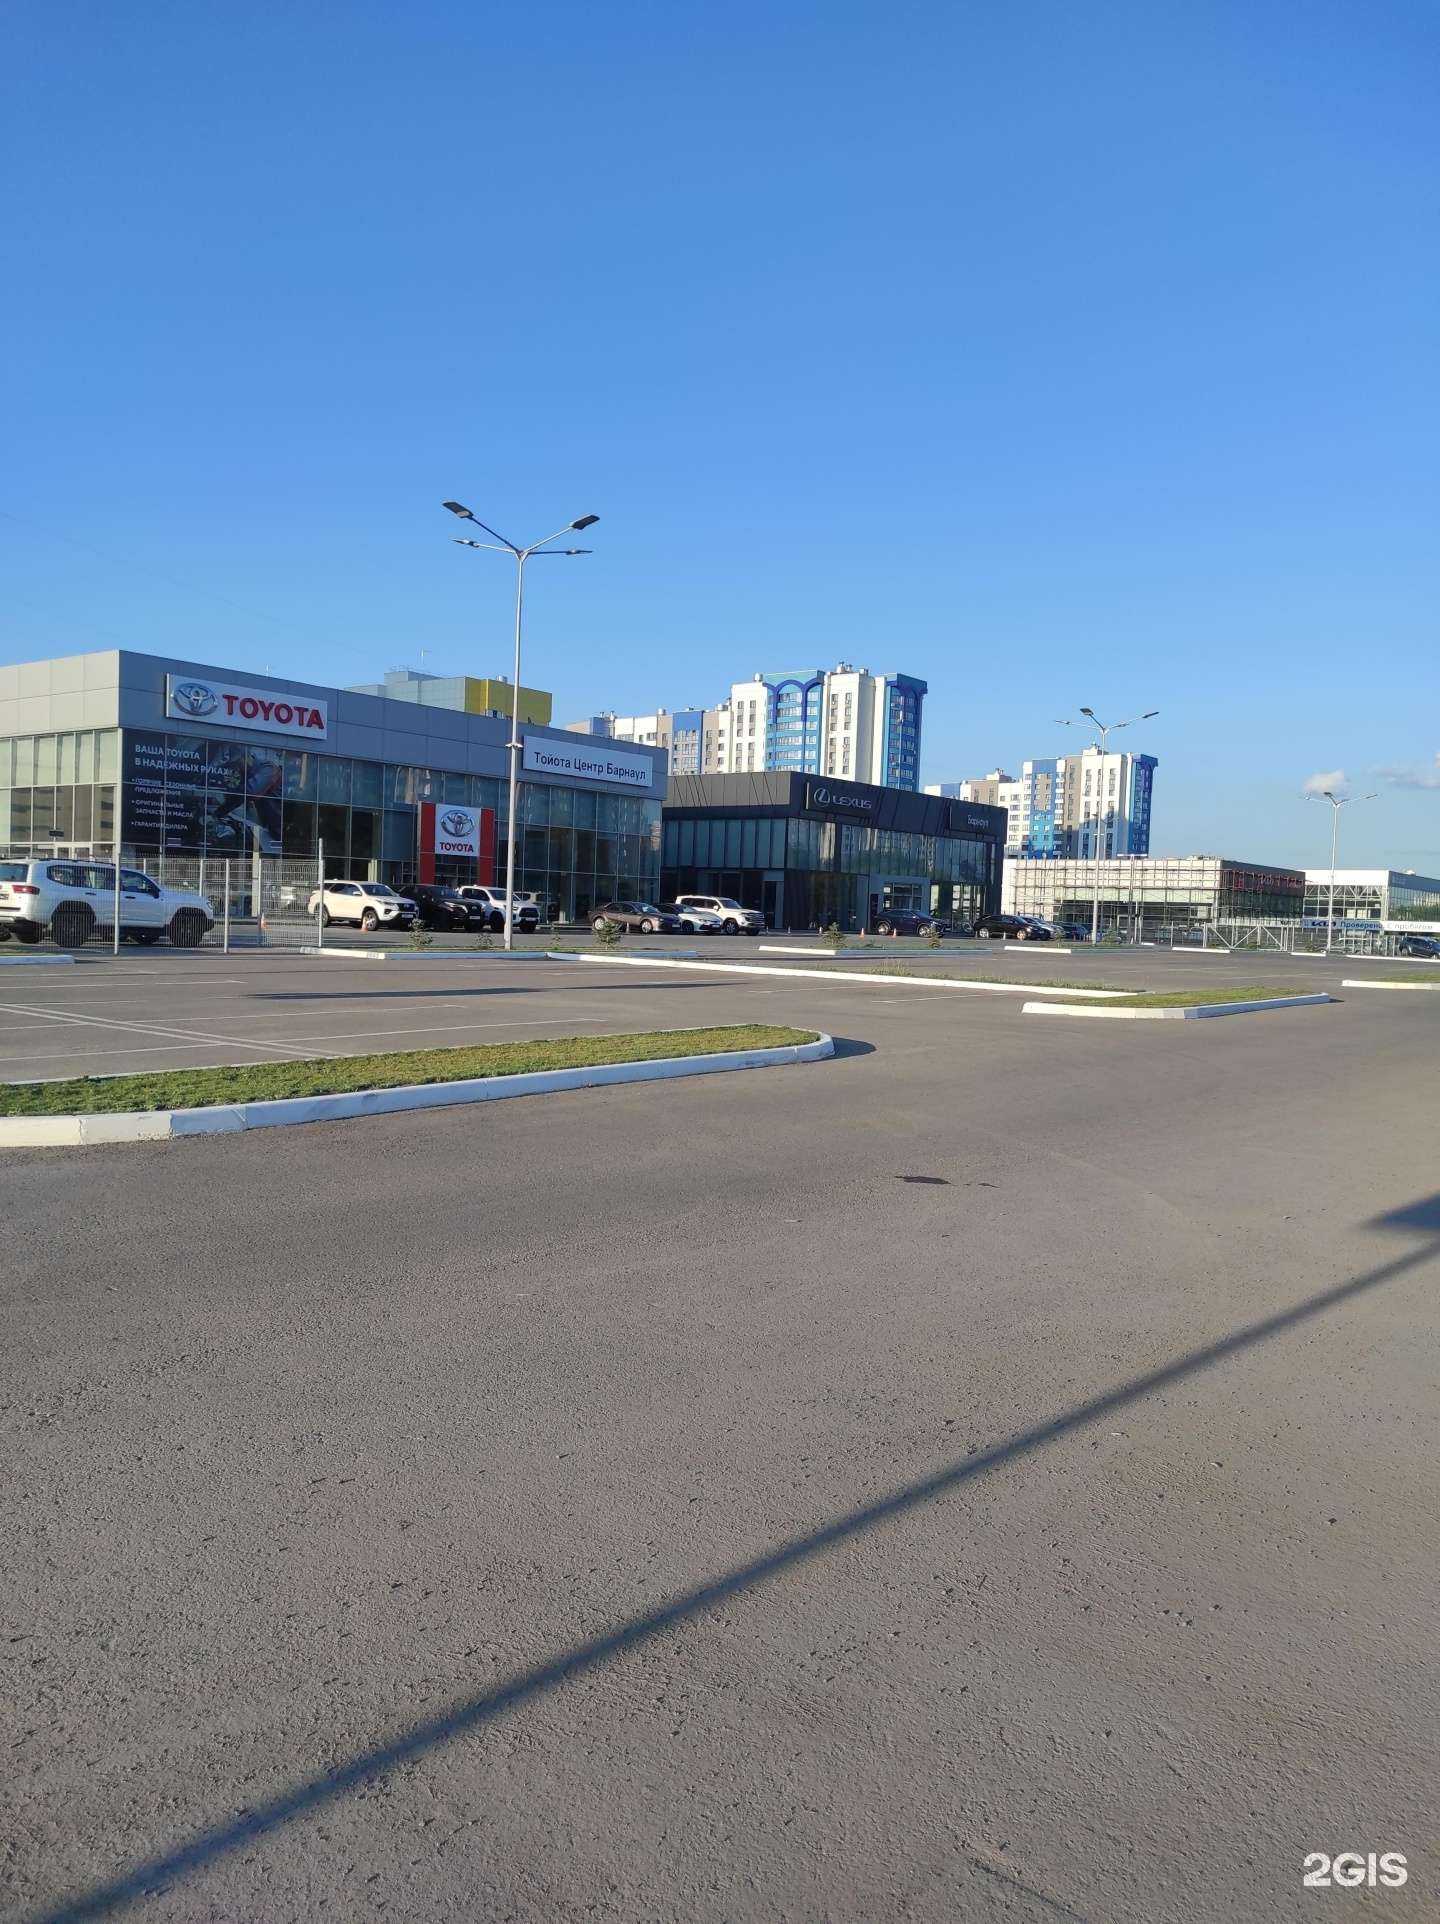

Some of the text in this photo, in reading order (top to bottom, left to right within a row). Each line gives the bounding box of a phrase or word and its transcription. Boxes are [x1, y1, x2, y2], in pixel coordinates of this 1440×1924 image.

[223, 694, 325, 730] TOYOTA
[135, 744, 200, 760] ВАША TOYOTA
[142, 758, 199, 773] НАДЕЖНЫХ
[534, 751, 646, 780] Тойота Центр Барнаул
[832, 795, 872, 809] LEXUS
[440, 841, 474, 853] TOYOTA
